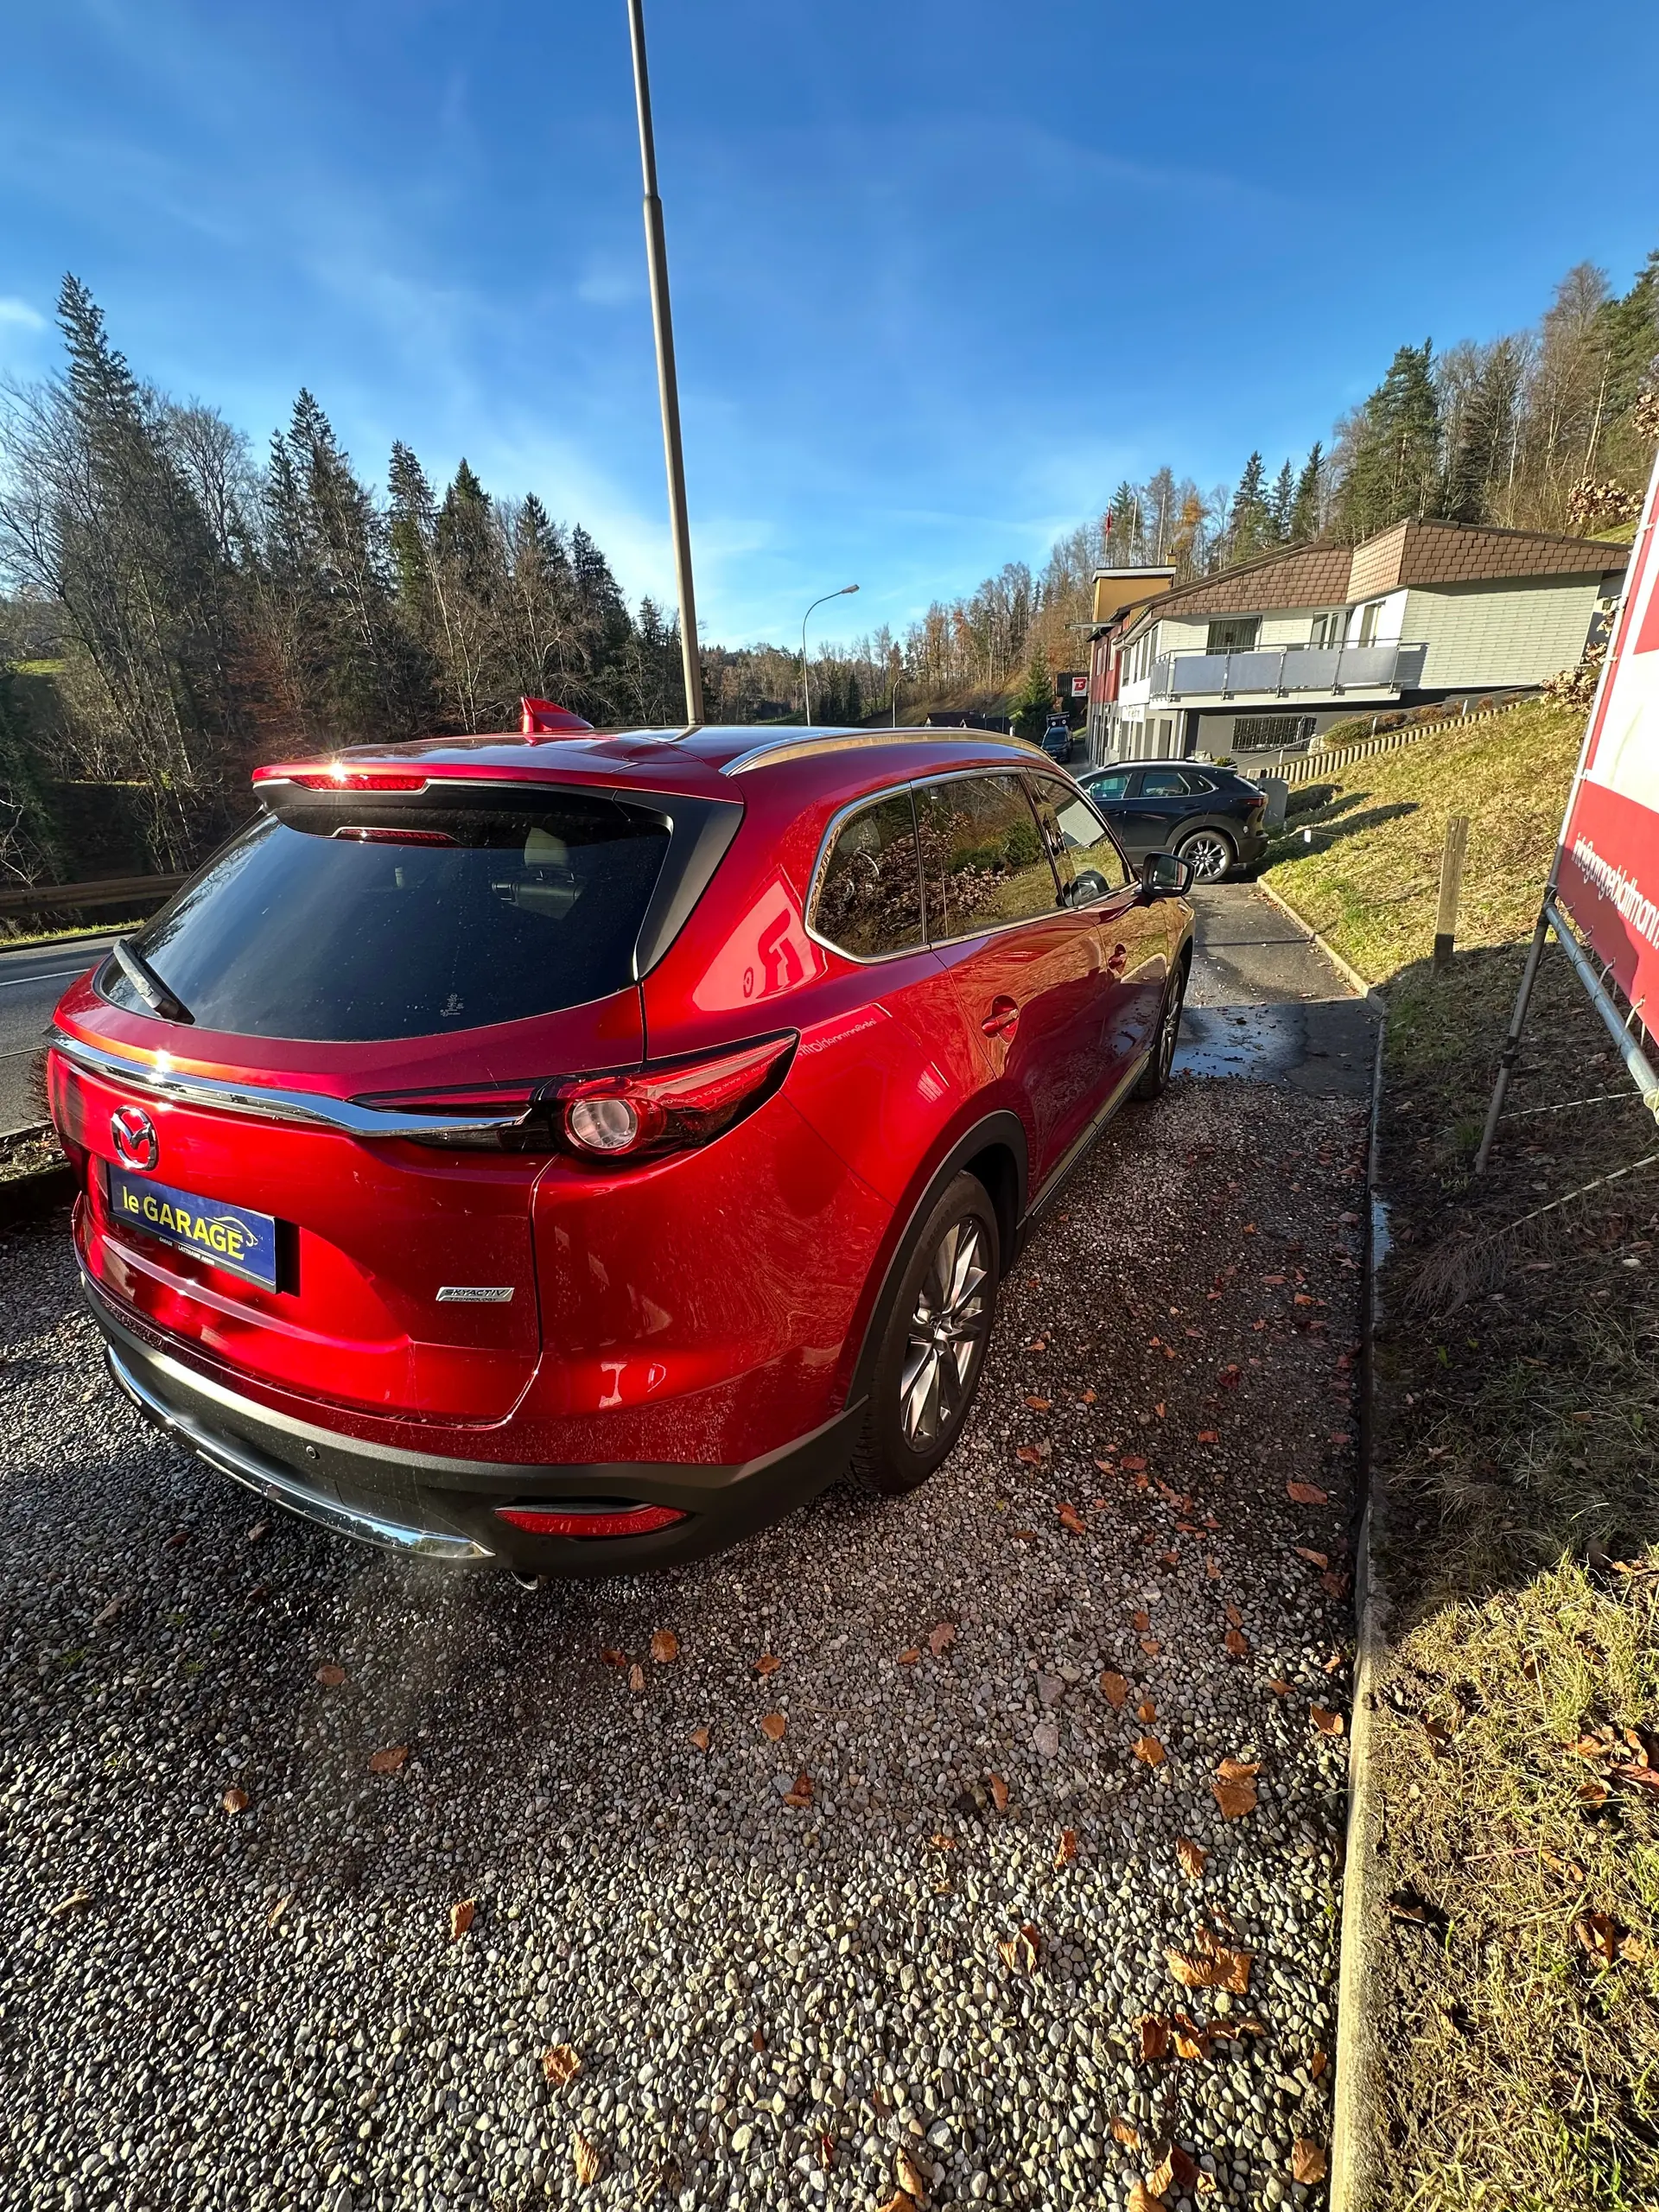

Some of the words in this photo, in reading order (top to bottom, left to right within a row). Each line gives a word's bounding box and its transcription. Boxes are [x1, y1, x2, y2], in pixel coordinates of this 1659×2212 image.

[123, 1185, 139, 1214] le
[143, 1196, 245, 1261] GARAGE
[444, 1288, 505, 1297] SKYACTIV
